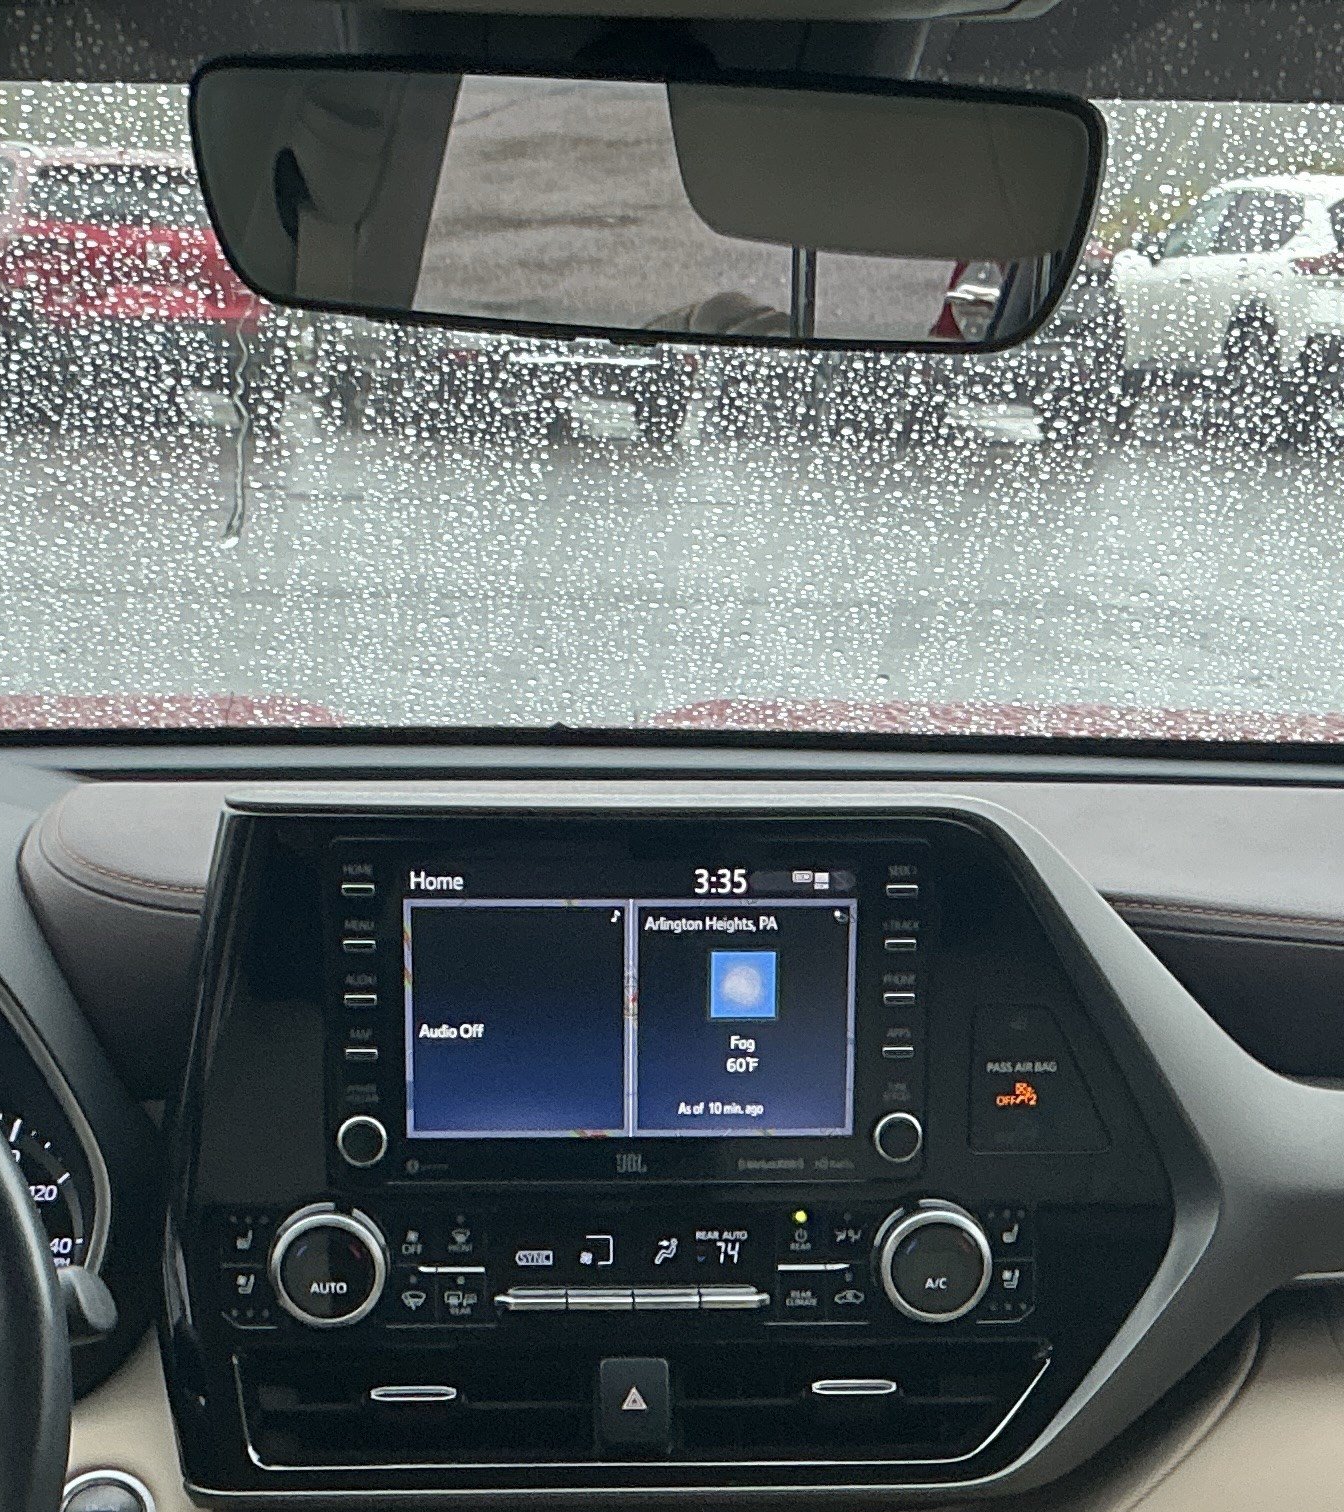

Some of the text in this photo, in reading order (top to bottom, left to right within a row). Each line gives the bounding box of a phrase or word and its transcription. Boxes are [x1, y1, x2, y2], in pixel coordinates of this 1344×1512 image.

[409, 870, 464, 890] Home
[693, 868, 747, 894] 3:35
[644, 915, 778, 934] Arlington Heights, PA
[418, 1022, 485, 1039] Audio Off
[729, 1035, 755, 1052] Fog
[995, 1095, 1016, 1106] OFF
[677, 1101, 763, 1117] As of 10 min. ago
[695, 1230, 748, 1240] REAR AUTO
[50, 1237, 72, 1254] 40
[401, 1243, 423, 1255] OFF
[716, 1241, 740, 1264] 74
[518, 1251, 551, 1264] SYNC
[309, 1282, 348, 1295] AUTO
[925, 1277, 948, 1290] A/C
